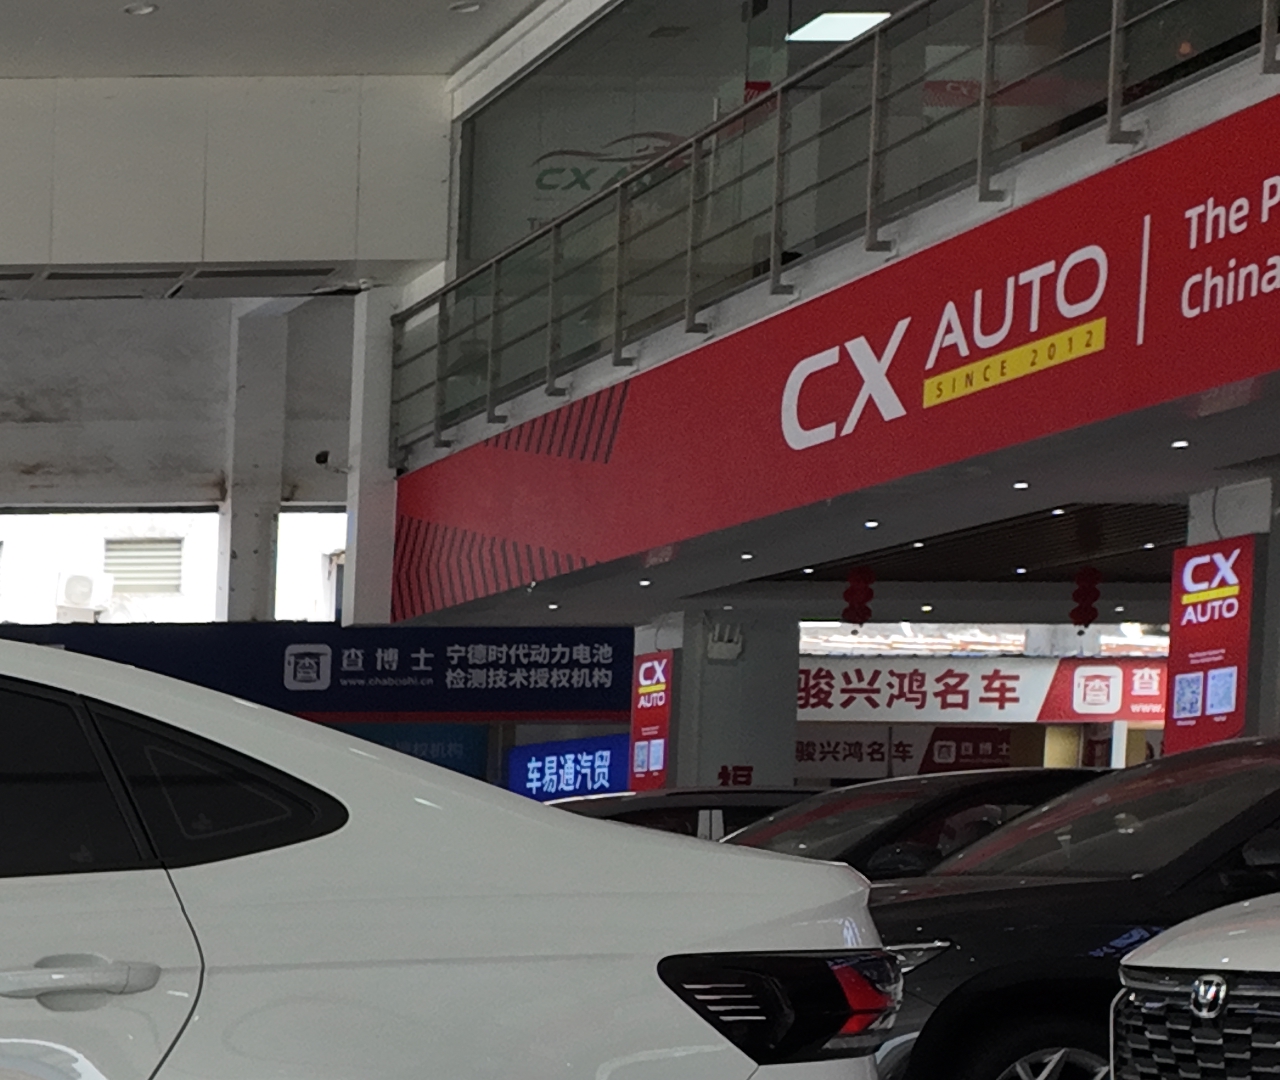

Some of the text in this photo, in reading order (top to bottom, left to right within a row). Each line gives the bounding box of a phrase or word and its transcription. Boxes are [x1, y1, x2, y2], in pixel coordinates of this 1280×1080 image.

[535, 167, 597, 191] CX
[1184, 196, 1250, 250] The
[781, 244, 1108, 451] CX AUTO
[936, 330, 1094, 399] SINCE 2012
[1182, 548, 1241, 593] CX
[1181, 598, 1239, 626] AUTO
[340, 643, 614, 671] 查博士 宁德时代动力电池
[445, 667, 613, 690] 检测技术授权机构
[638, 659, 667, 686] CX
[637, 691, 666, 709] AUTO
[797, 667, 1162, 710] 骏兴鸿名车 查
[796, 740, 914, 763] 骏兴鸿名车
[525, 750, 612, 795] 车易通汽贸
